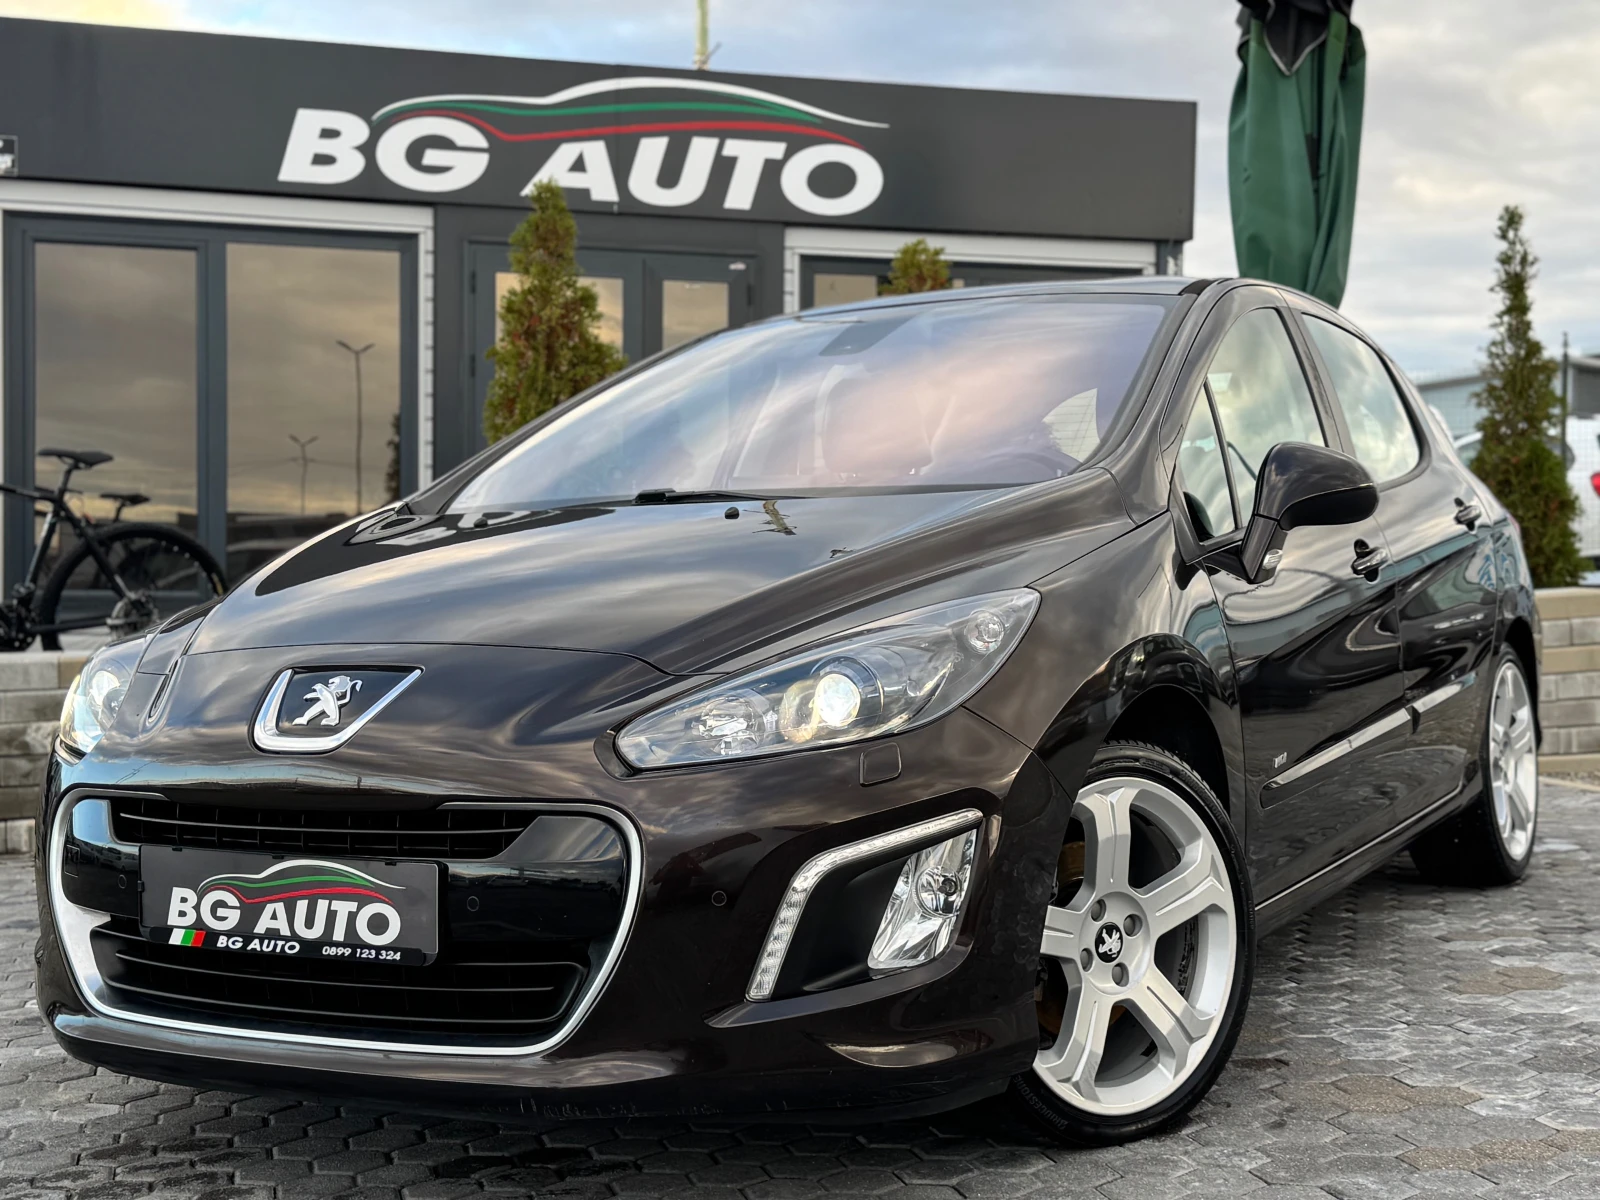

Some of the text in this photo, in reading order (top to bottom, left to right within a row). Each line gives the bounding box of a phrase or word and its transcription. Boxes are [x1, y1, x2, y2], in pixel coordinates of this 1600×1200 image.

[278, 108, 884, 216] BG AUTO
[167, 886, 401, 946] BG AUTO
[216, 935, 301, 954] BG AUTO
[321, 946, 402, 961] 0899 123 324
